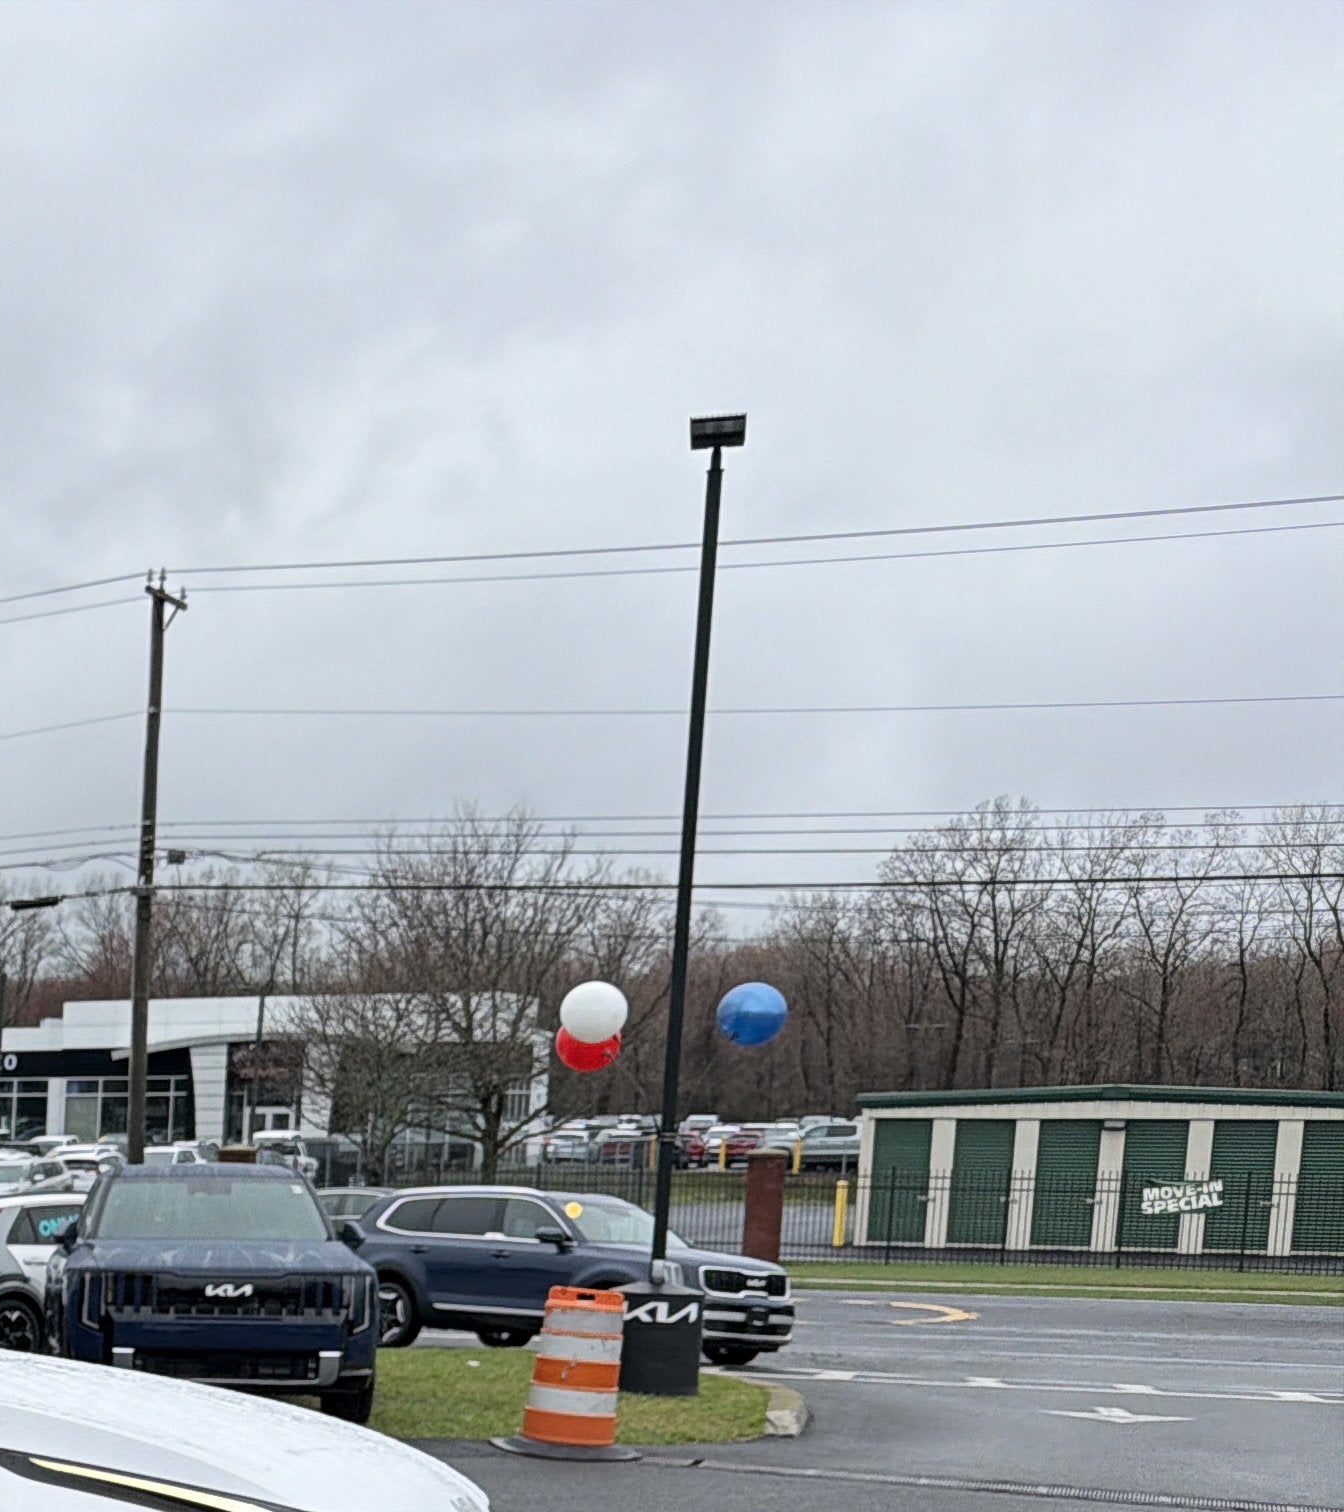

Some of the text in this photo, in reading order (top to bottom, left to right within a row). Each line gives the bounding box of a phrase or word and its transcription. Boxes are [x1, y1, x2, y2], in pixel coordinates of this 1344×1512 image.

[1142, 1179, 1224, 1202] MOVE-IN
[1140, 1192, 1224, 1215] SPECIAL
[204, 1283, 254, 1298] KIA
